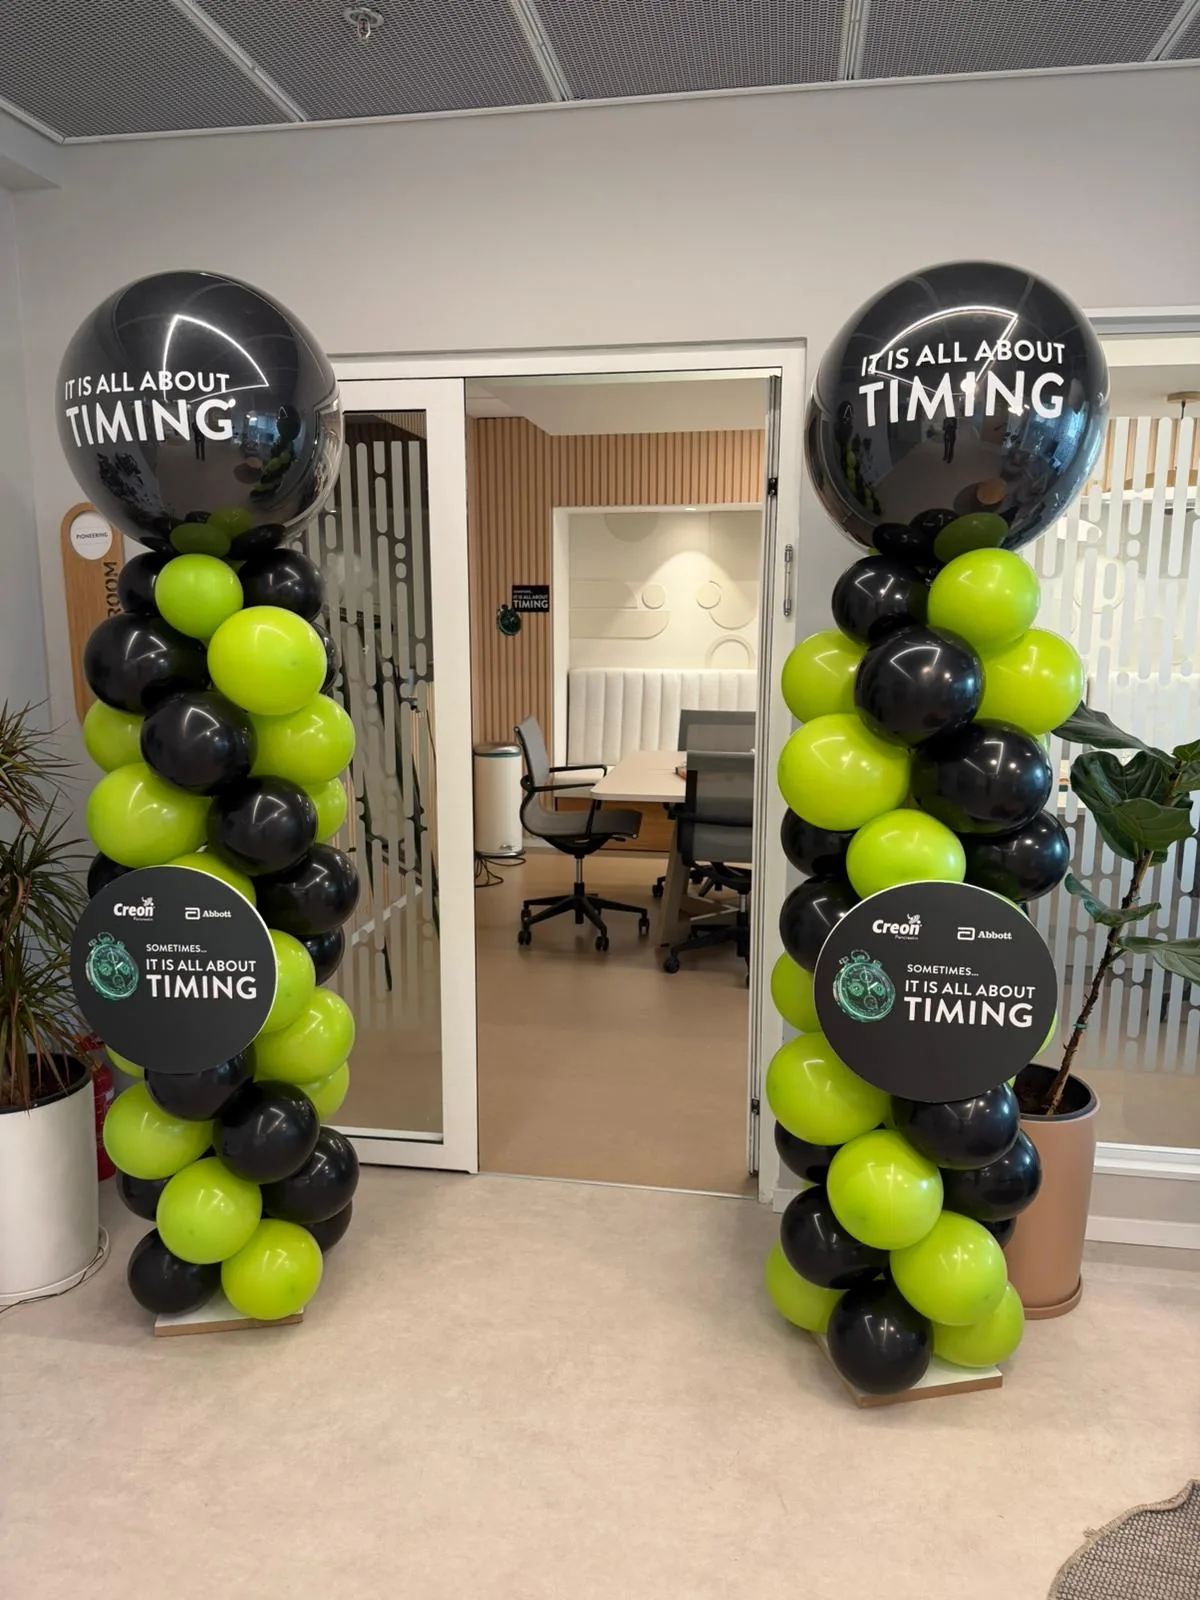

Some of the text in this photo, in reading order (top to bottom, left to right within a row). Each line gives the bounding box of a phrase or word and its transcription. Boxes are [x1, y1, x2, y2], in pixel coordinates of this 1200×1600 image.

[861, 340, 1065, 377] IT IS ALL ABOUT
[65, 370, 230, 400] IT IS ALL ABOUT
[859, 370, 1065, 427] TIMING
[65, 398, 234, 447] TIMING
[513, 600, 548, 608] TIMING
[113, 903, 154, 917] Creon
[202, 910, 232, 918] Abbott
[872, 919, 920, 936] Creon
[978, 930, 1012, 940] Abbott
[146, 944, 207, 953] SOMETIMES...
[146, 958, 256, 972] IT IS ALL ABOUT
[907, 964, 979, 976] SOMETIMES...
[146, 974, 257, 1000] TIMING
[905, 980, 1036, 999] IT IS ALL ABOUT
[904, 996, 1033, 1028] TIMING
